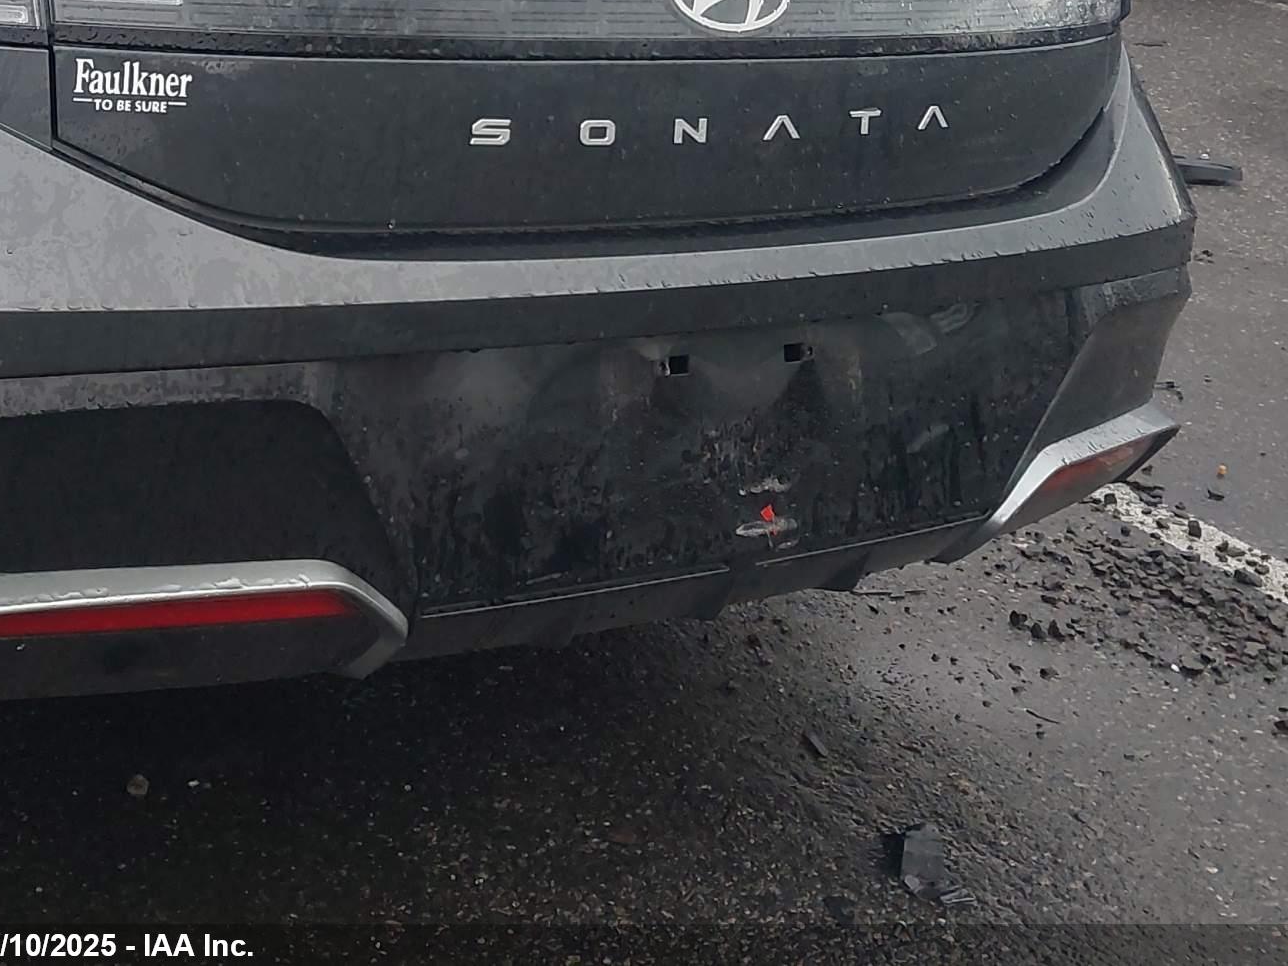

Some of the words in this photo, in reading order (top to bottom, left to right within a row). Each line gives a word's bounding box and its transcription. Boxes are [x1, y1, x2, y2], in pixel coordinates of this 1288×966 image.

[73, 58, 193, 97] Faulkner
[94, 99, 113, 111] TO
[116, 100, 132, 112] BE
[134, 101, 167, 113] SURE
[469, 105, 949, 146] SONATA
